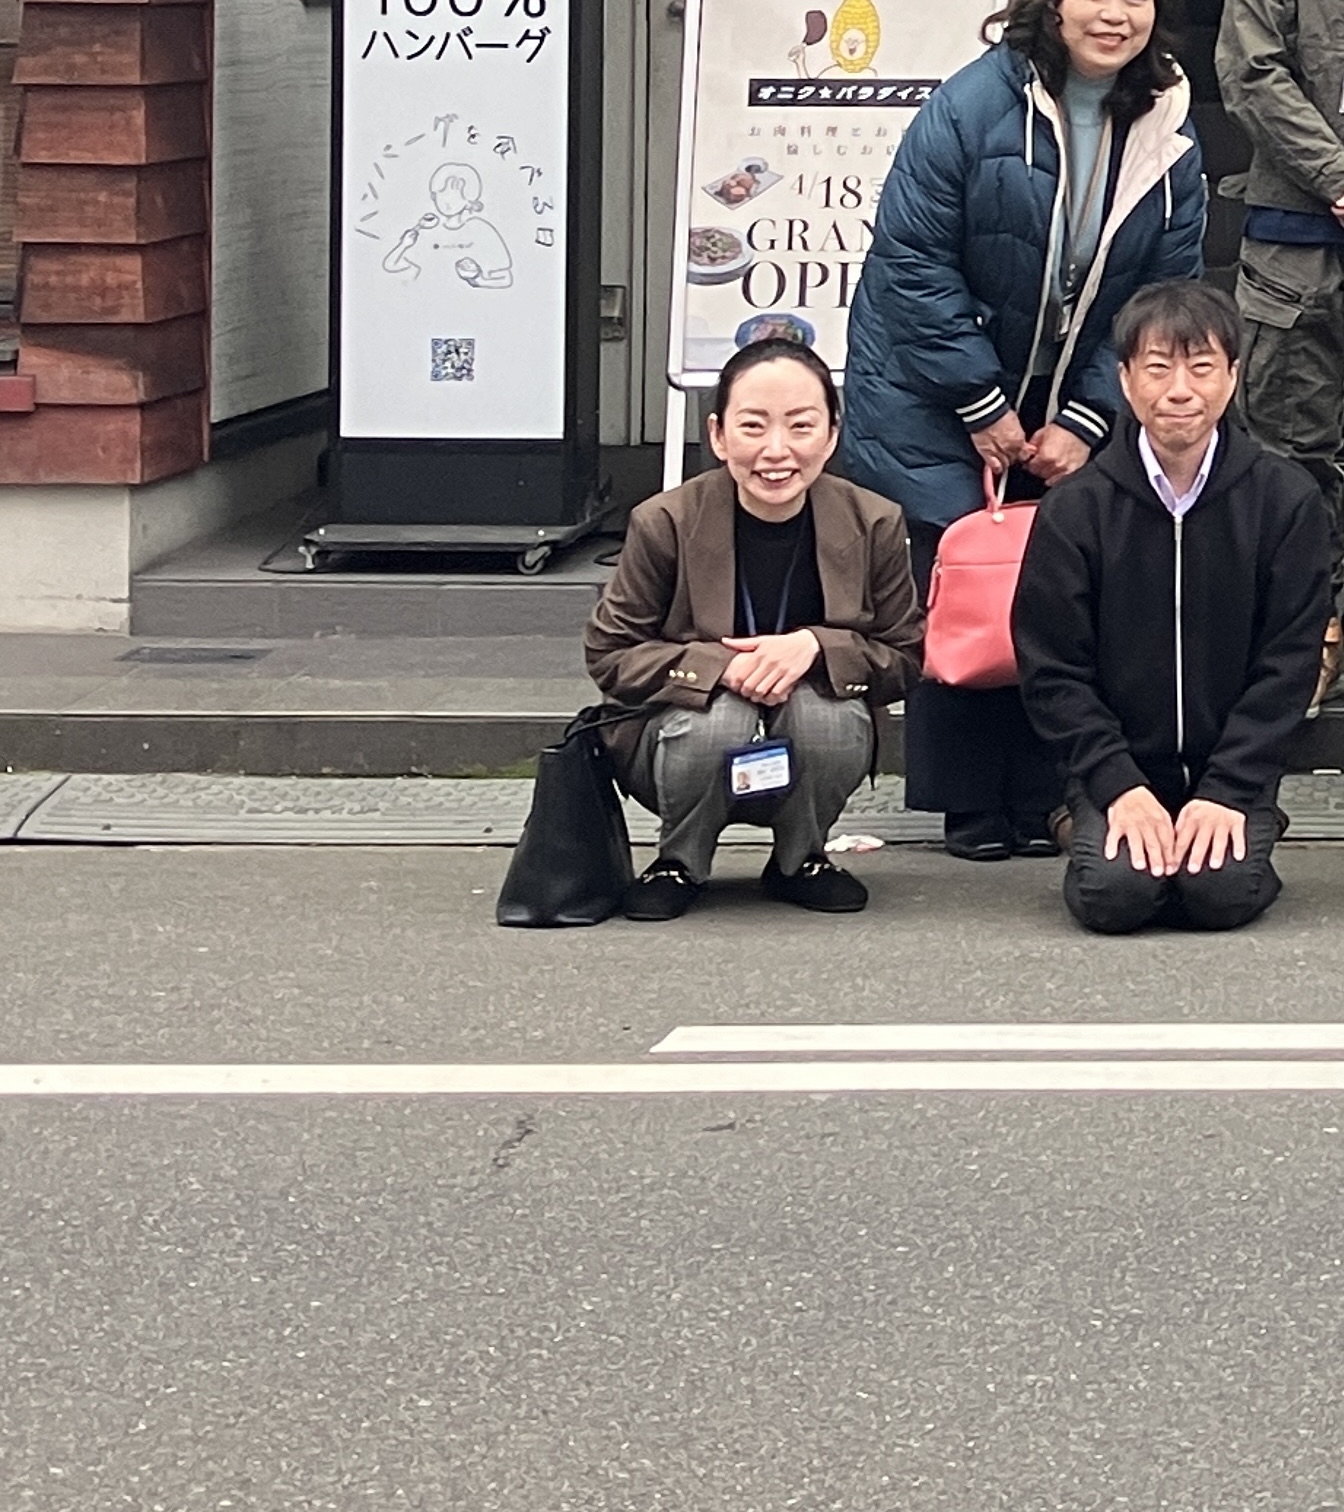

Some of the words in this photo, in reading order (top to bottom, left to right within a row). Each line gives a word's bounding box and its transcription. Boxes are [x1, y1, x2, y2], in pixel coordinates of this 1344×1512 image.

[361, 26, 552, 65] ハンバーグ
[748, 125, 908, 138] お肉料理とお
[790, 172, 863, 210] 4/18
[746, 217, 875, 253] GRAN
[741, 259, 865, 309] OPE
